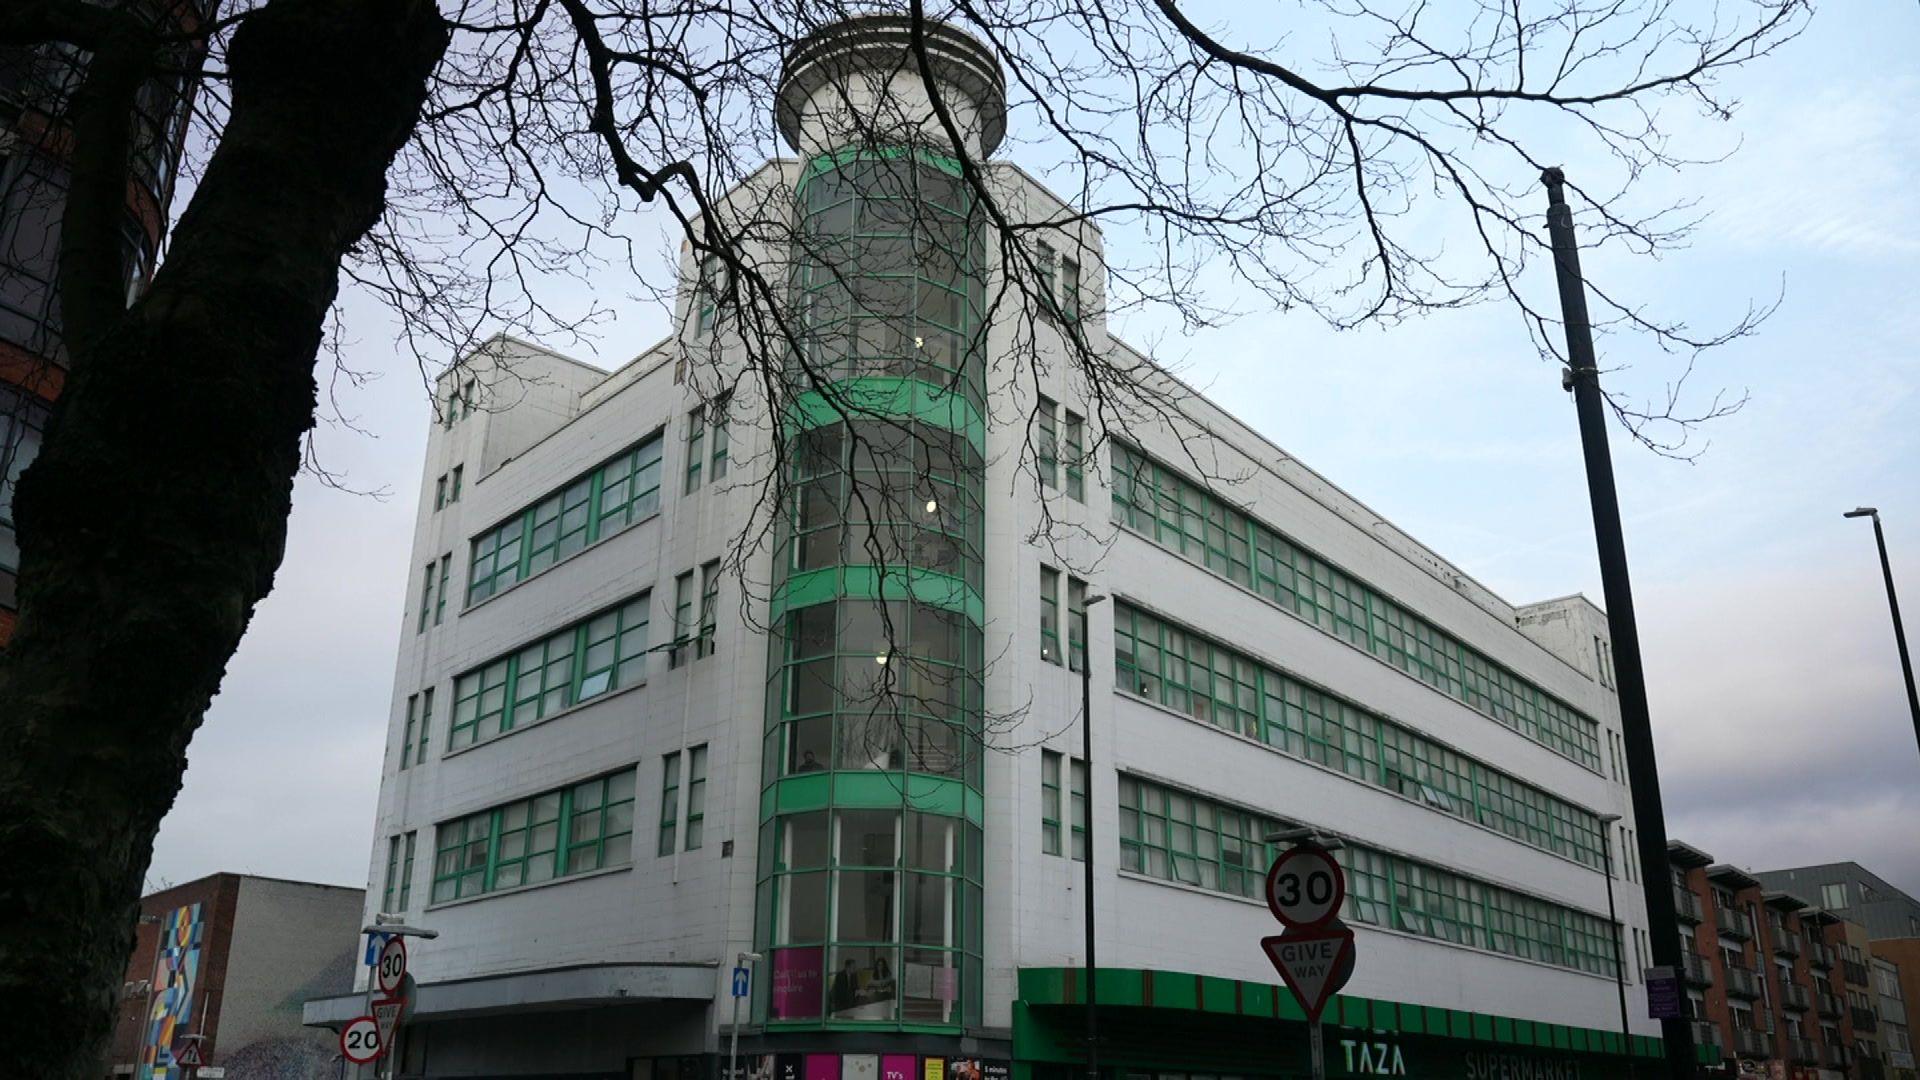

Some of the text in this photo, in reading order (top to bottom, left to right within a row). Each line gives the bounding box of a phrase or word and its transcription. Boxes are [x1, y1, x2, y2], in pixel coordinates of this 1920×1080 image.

[1278, 871, 1333, 907] 30
[1281, 943, 1333, 963] GIVE
[382, 954, 402, 978] 30
[1294, 964, 1326, 979] WAY
[376, 1006, 397, 1018] GIVE
[348, 1031, 379, 1049] 20
[1340, 1039, 1581, 1080] TAZA SUPERMARKET
